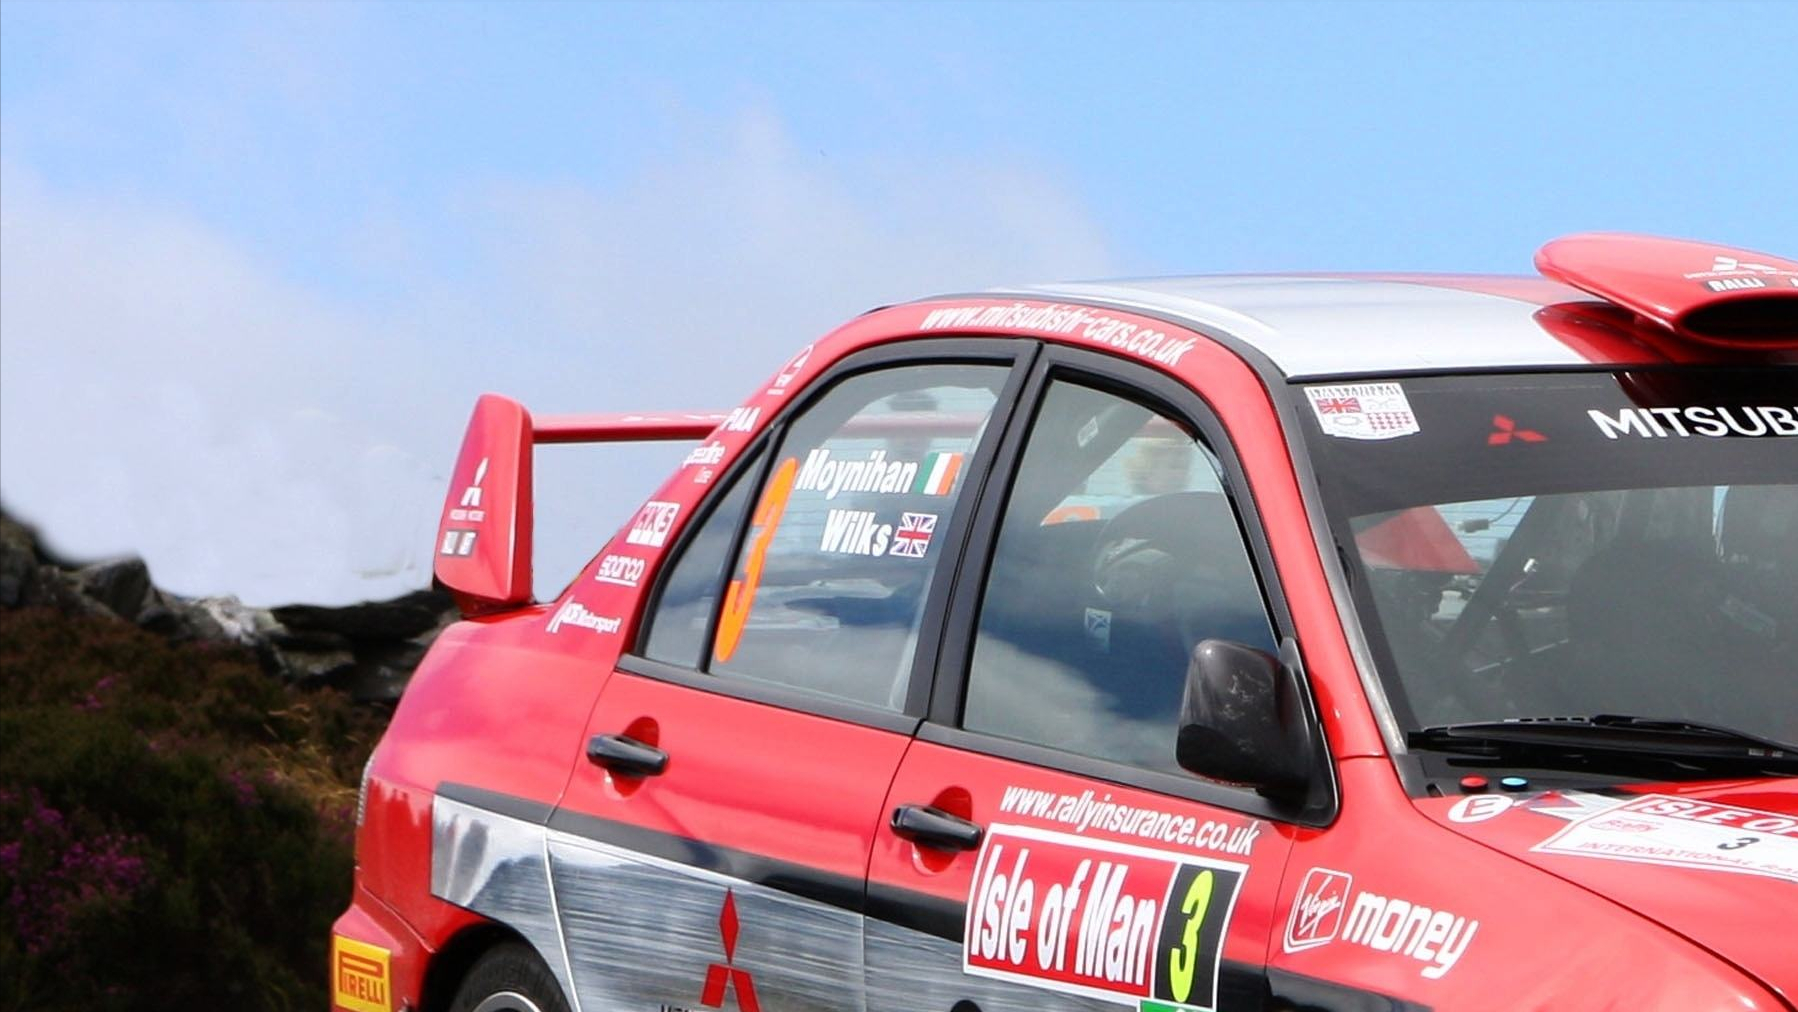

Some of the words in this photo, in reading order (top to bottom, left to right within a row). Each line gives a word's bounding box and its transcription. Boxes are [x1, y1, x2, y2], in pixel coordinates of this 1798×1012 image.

[796, 449, 918, 500] Moynihan
[714, 457, 797, 664] 3
[820, 509, 893, 557] Wilks
[999, 785, 1262, 857] www.rallyinsurance.co.uk
[1622, 799, 1752, 828] ISLE
[1717, 837, 1760, 850] 3
[971, 844, 1034, 965] Isle
[1037, 859, 1093, 972] of
[1075, 861, 1156, 986] Man
[1170, 870, 1214, 1004] 3
[1341, 891, 1479, 980] money
[338, 951, 387, 1005] PIRELLI
